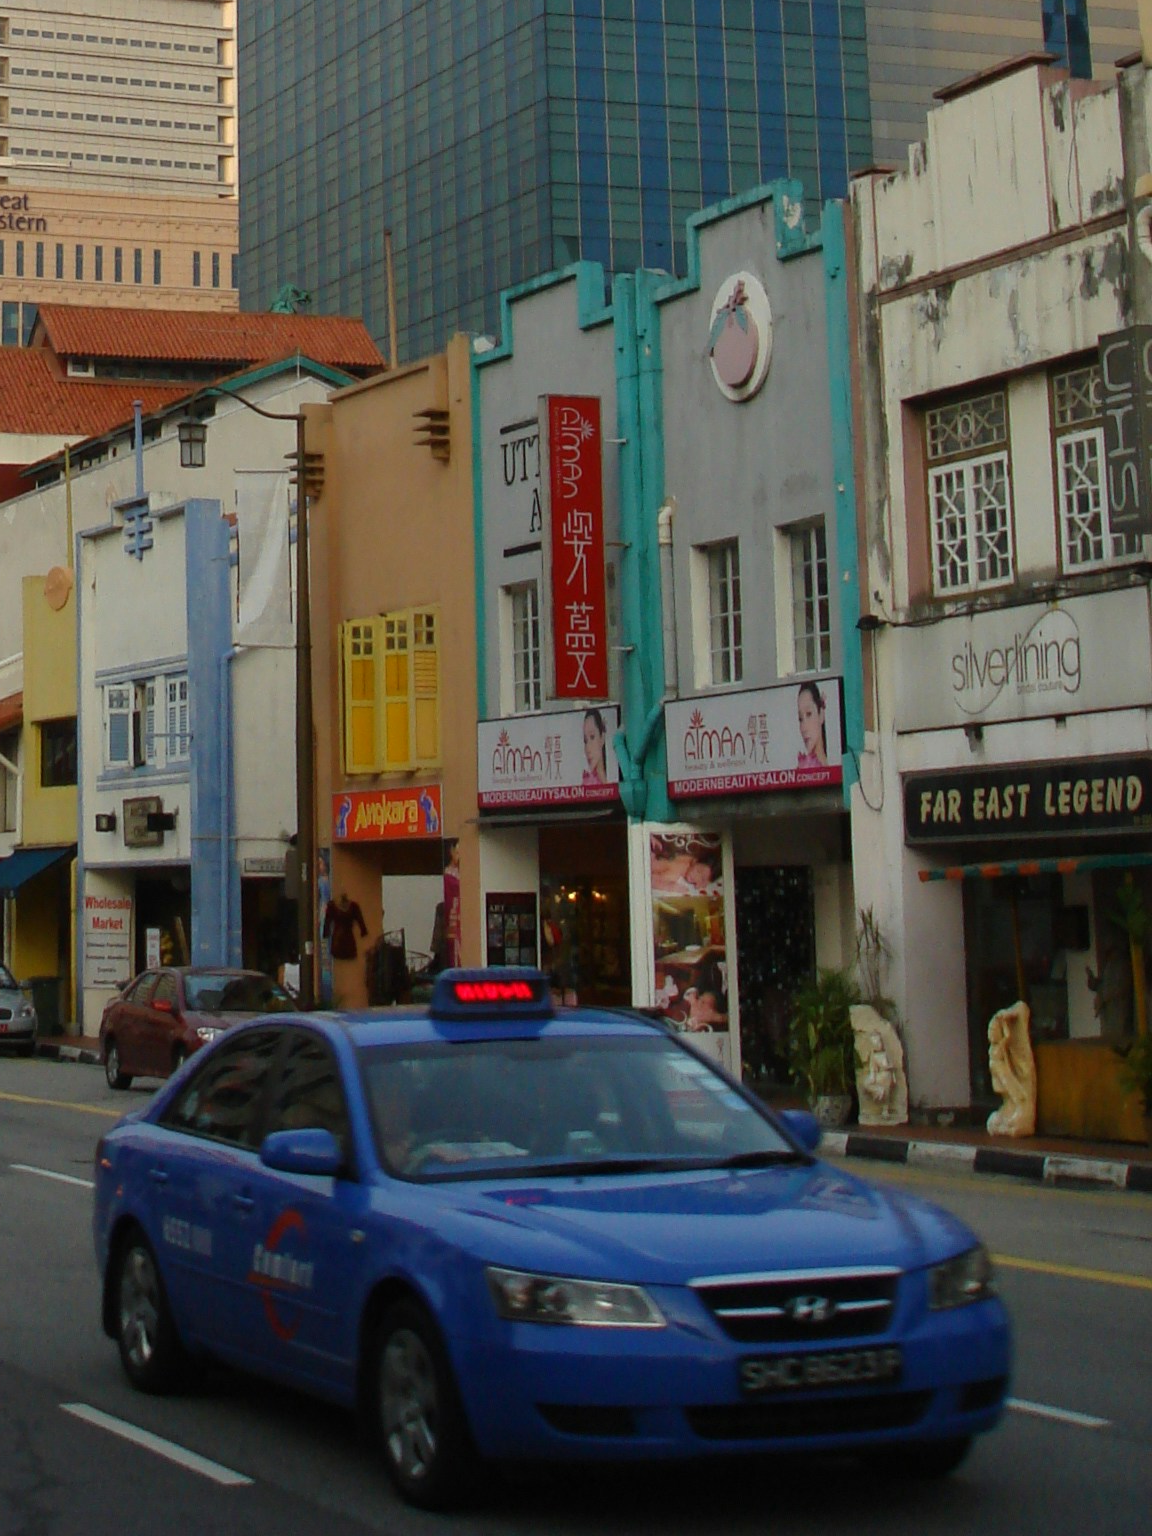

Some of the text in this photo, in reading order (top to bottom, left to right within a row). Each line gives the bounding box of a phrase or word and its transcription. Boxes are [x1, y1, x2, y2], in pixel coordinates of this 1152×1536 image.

[952, 630, 1081, 694] silverlining
[920, 775, 1143, 824] FAR EAST LEGEND
[85, 895, 132, 910] Wholesale
[92, 916, 124, 930] Market
